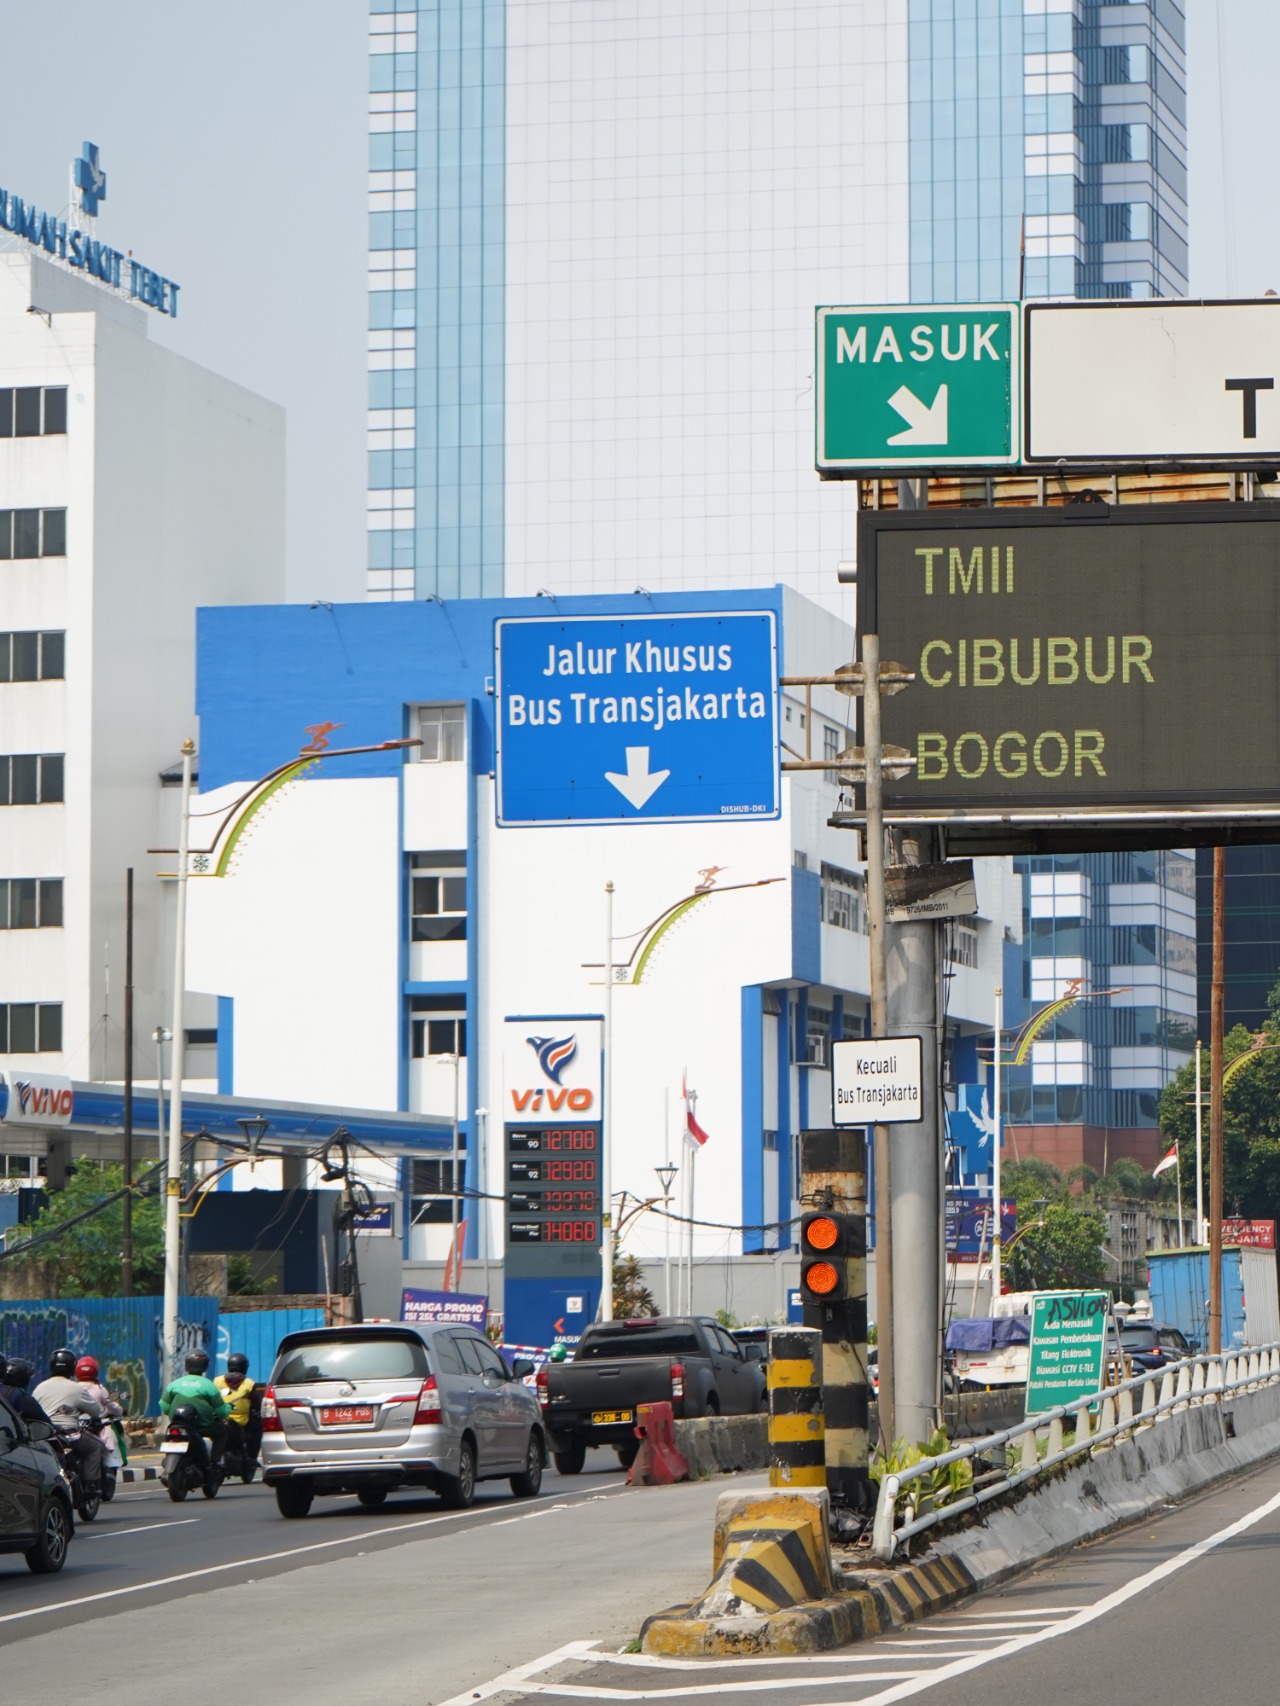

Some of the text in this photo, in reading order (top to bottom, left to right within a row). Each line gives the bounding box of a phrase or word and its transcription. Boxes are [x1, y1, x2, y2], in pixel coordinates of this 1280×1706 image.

[0, 187, 180, 318] UMAH SAKIT TEBET
[836, 323, 1000, 364] MASUK
[915, 546, 1014, 594] TMII
[543, 640, 732, 676] Jalur Khusus
[920, 635, 1155, 687] CIBUBUR
[509, 687, 766, 730] Bus Transjakarta
[917, 729, 1107, 780] BOGOR
[720, 804, 766, 813] DISHUB-DKI
[856, 1056, 897, 1075] Kecuali
[837, 1084, 918, 1106] Bus Transjakarta
[545, 1130, 595, 1150] 12700
[545, 1161, 595, 1180] 12920
[545, 1222, 595, 1241] 14060
[404, 1302, 484, 1313] HARGA PROMO
[436, 1313, 471, 1322] GRATIS
[1062, 1318, 1093, 1328] Memasuki
[1033, 1336, 1059, 1345] Kawasan
[1041, 1348, 1092, 1361] Tilang Elektronik
[1036, 1365, 1060, 1375] Diawasi
[1062, 1364, 1077, 1374] CCTV
